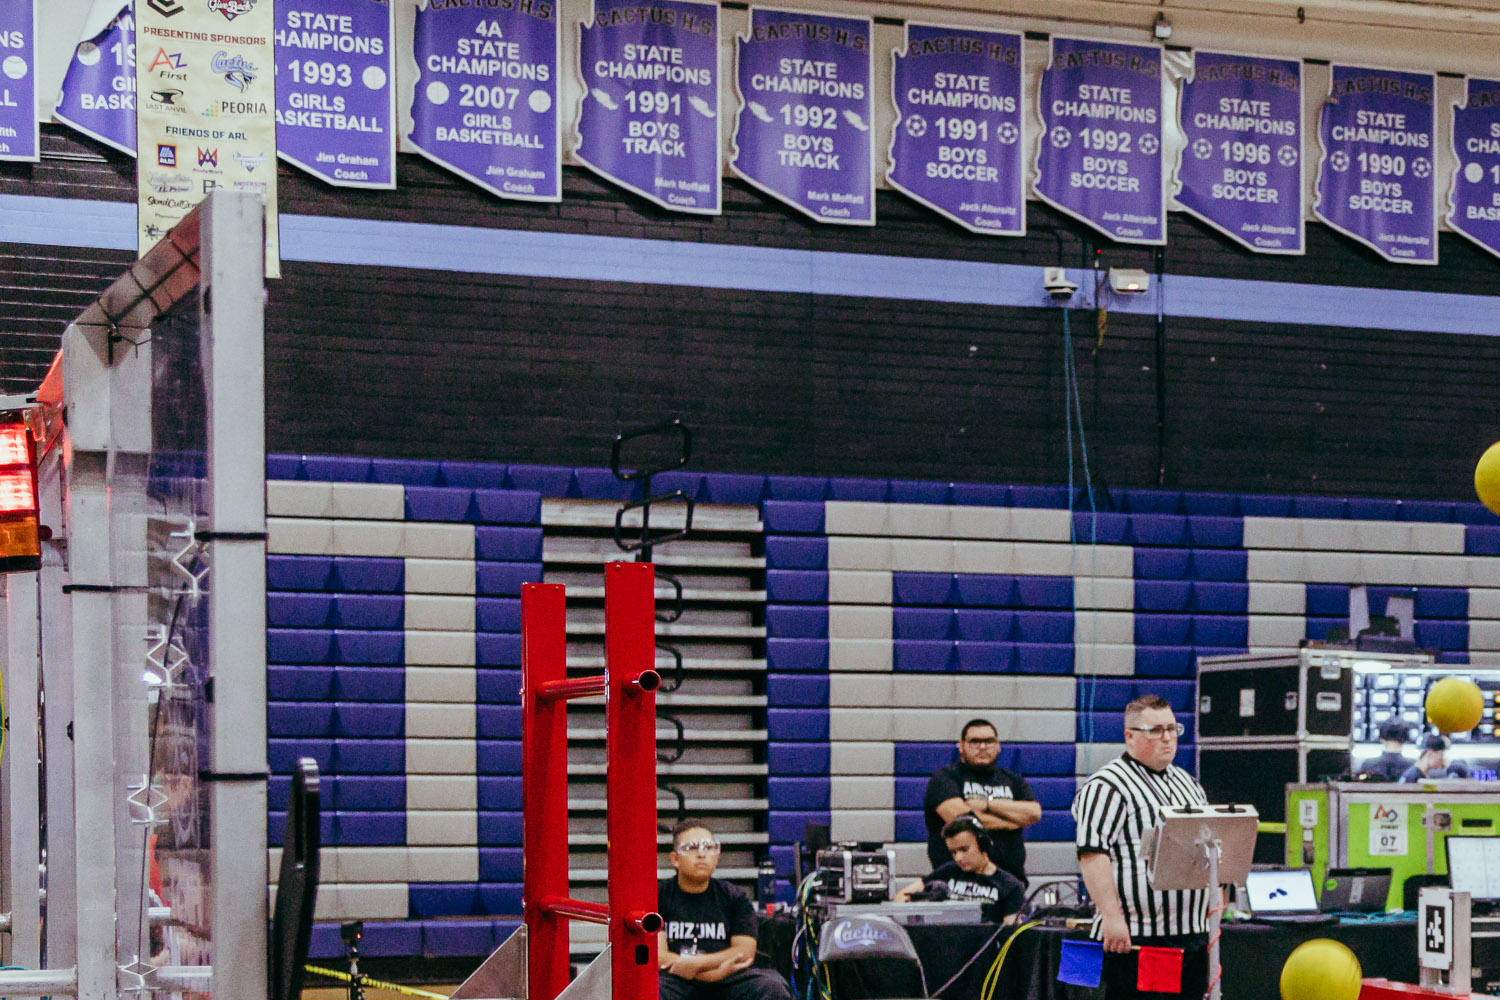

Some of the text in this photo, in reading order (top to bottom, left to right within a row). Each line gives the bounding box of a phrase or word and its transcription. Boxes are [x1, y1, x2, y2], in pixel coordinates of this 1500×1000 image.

[287, 11, 353, 33] STATE
[596, 7, 676, 28] CACTUS
[143, 26, 267, 45] PRESENTING SPONSORS
[475, 20, 503, 38] 4A
[752, 22, 830, 41] CACTUS
[275, 29, 384, 55] HAMPIONS
[457, 38, 521, 60] STATE
[909, 37, 983, 57] CACTUS
[624, 43, 683, 64] STATE
[160, 71, 188, 81] First
[288, 59, 352, 87] 1993
[427, 55, 550, 82] CHAMPIONS
[594, 60, 712, 86] CHAMPIONS
[779, 58, 838, 79] STATE
[751, 74, 865, 100] CHAMPIONS
[934, 72, 990, 92] STATE
[1334, 77, 1399, 95] CACTUS
[288, 92, 346, 113] GIRLS
[459, 83, 520, 110] 2007
[624, 90, 681, 116] 1991
[908, 88, 1016, 113] CHAMPIONS
[1078, 84, 1132, 104] STATE
[221, 101, 267, 114] PEORIA
[779, 103, 838, 130] 1992
[1052, 100, 1158, 124] CHAMPIONS
[1219, 97, 1271, 117] STATE
[275, 109, 383, 133] ASKETBALL
[462, 112, 512, 130] GIRLS
[934, 117, 989, 142] 1991
[1194, 113, 1296, 136] CHAMPIONS
[1356, 110, 1406, 129] STATE
[165, 126, 248, 141] FRIENDS OF ARL
[435, 127, 544, 149] BASKETBALL
[629, 121, 680, 139] BOYS
[1332, 126, 1430, 149] CHAMPIONS
[622, 138, 686, 158] TRACK
[783, 134, 834, 153] BOYS
[1079, 128, 1132, 153] 1992
[316, 152, 379, 166] Jim Graham
[778, 150, 840, 171] TRACK
[938, 146, 988, 165] BOYS
[1219, 141, 1271, 165] 1996
[486, 165, 546, 179] Jim Graham
[926, 162, 999, 182] SOCCER
[1083, 156, 1129, 175] BOYS
[1357, 152, 1406, 176] 1990
[334, 169, 368, 181] Coach
[1070, 172, 1140, 192] SOCCER
[1223, 168, 1267, 186] BOYS
[503, 181, 535, 194] Coach
[1212, 184, 1279, 204] SOCCER
[1360, 179, 1403, 198] BOYS
[1349, 195, 1413, 214] SOCCER
[1380, 836, 1396, 846] 07
[834, 920, 894, 949] Cactus
